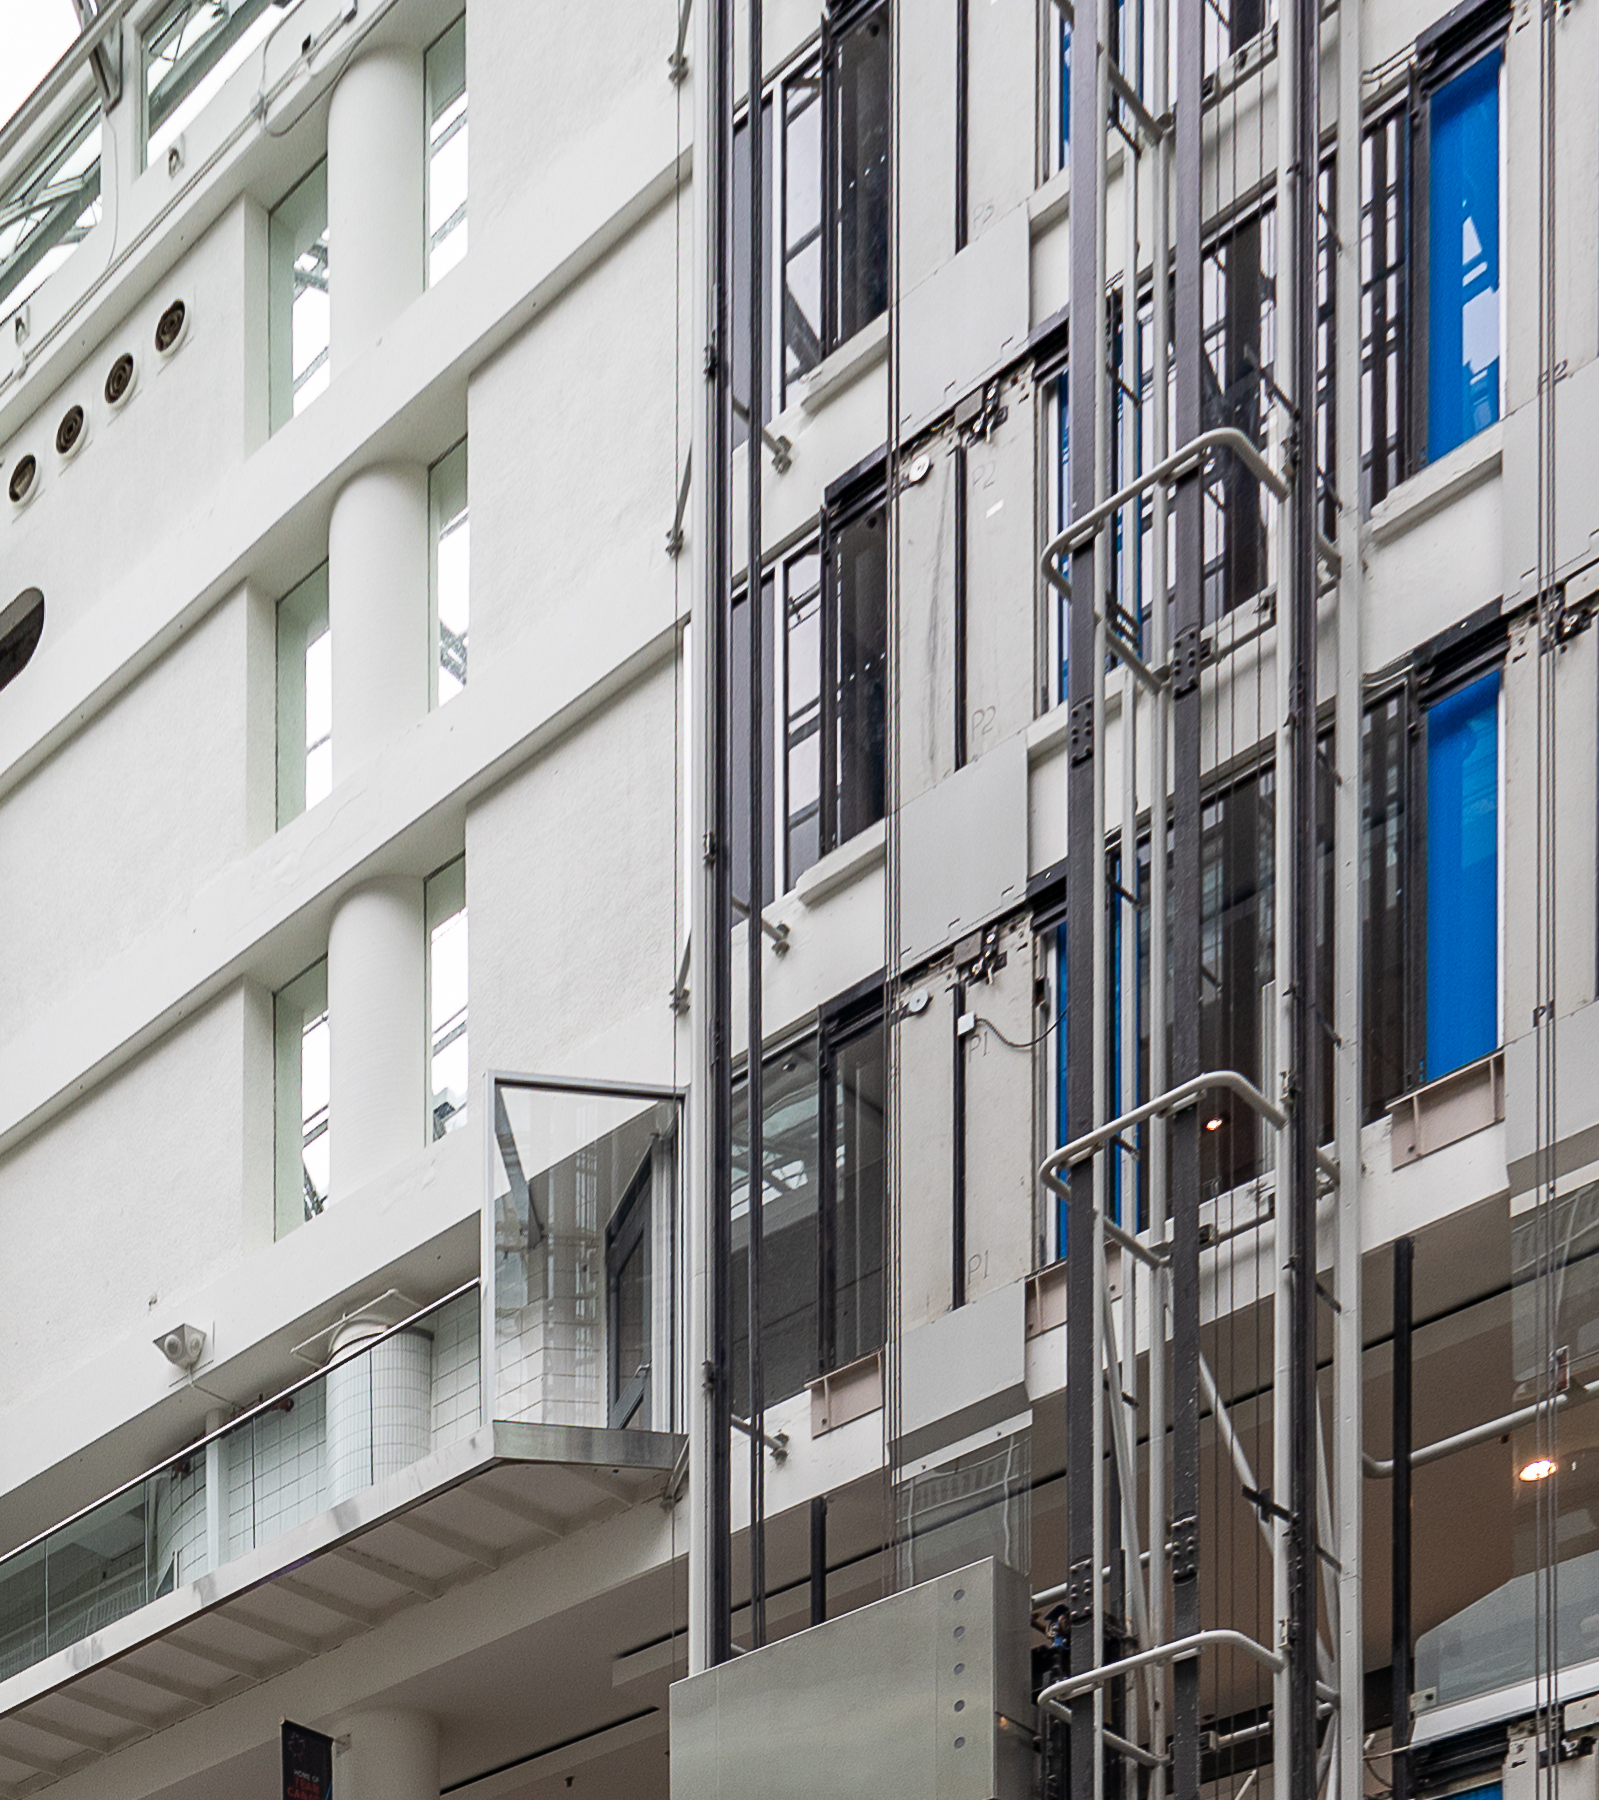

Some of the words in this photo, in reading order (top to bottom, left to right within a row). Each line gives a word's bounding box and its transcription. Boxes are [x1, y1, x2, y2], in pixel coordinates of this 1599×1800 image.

[972, 705, 996, 742] P2
[968, 1249, 989, 1285] P1
[293, 1769, 312, 1780] HOME
[294, 1776, 320, 1793] TEAM
